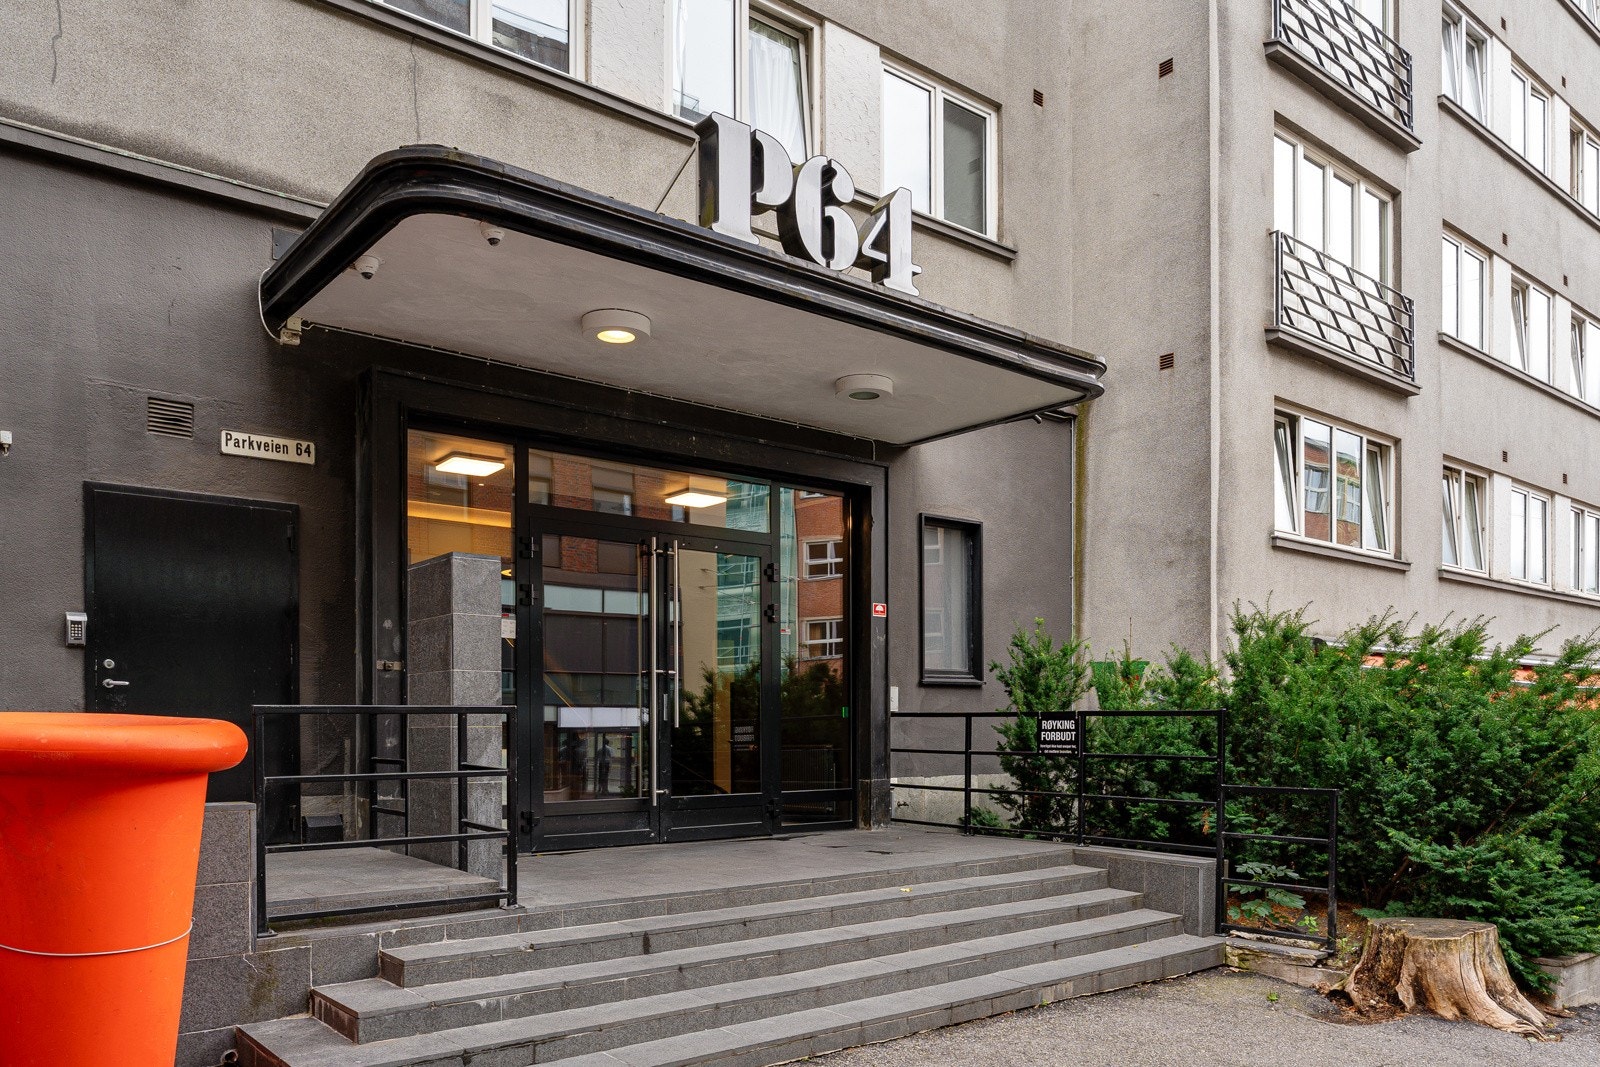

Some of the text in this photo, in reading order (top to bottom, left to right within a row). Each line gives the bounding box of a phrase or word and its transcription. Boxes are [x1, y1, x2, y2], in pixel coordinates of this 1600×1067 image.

[706, 111, 922, 297] P64
[225, 432, 312, 458] Parkveien 64
[1041, 719, 1076, 730] RØYKING
[1041, 731, 1077, 741] FORBUDT
